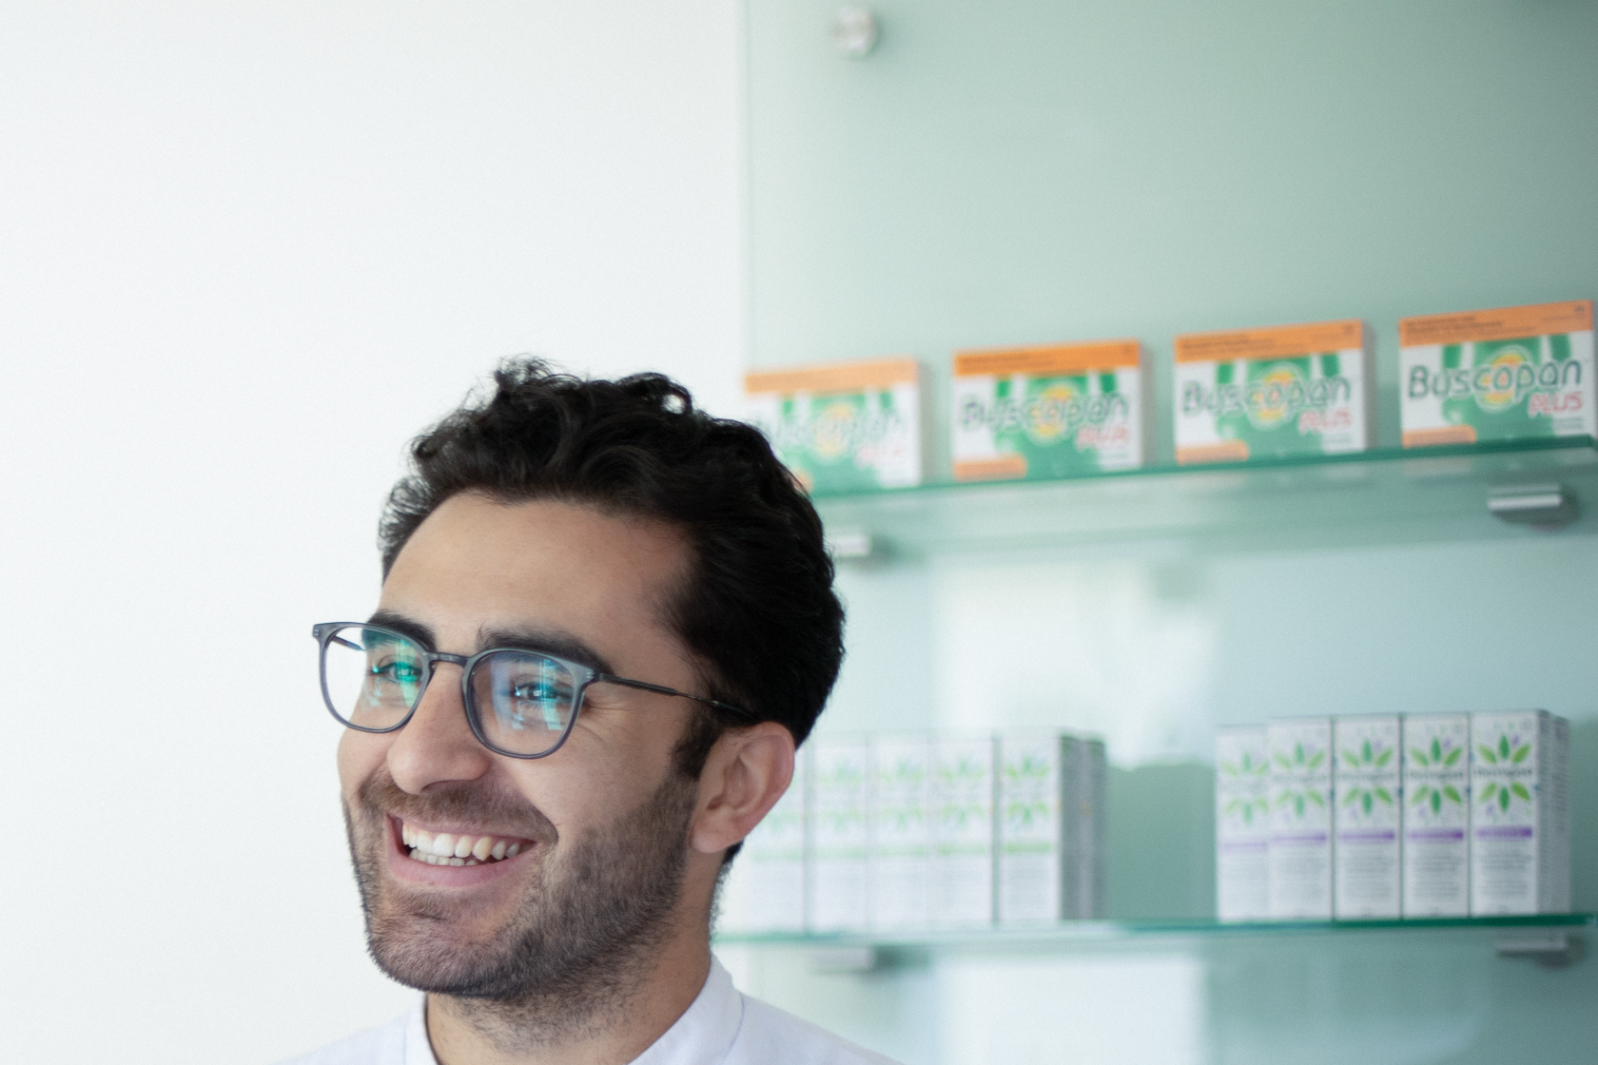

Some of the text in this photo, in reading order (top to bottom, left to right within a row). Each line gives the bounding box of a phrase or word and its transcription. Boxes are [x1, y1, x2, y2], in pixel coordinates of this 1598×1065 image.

[1182, 375, 1351, 422] Buscopan
[1408, 359, 1582, 404] Buscopan
[1528, 390, 1584, 419] PLUS
